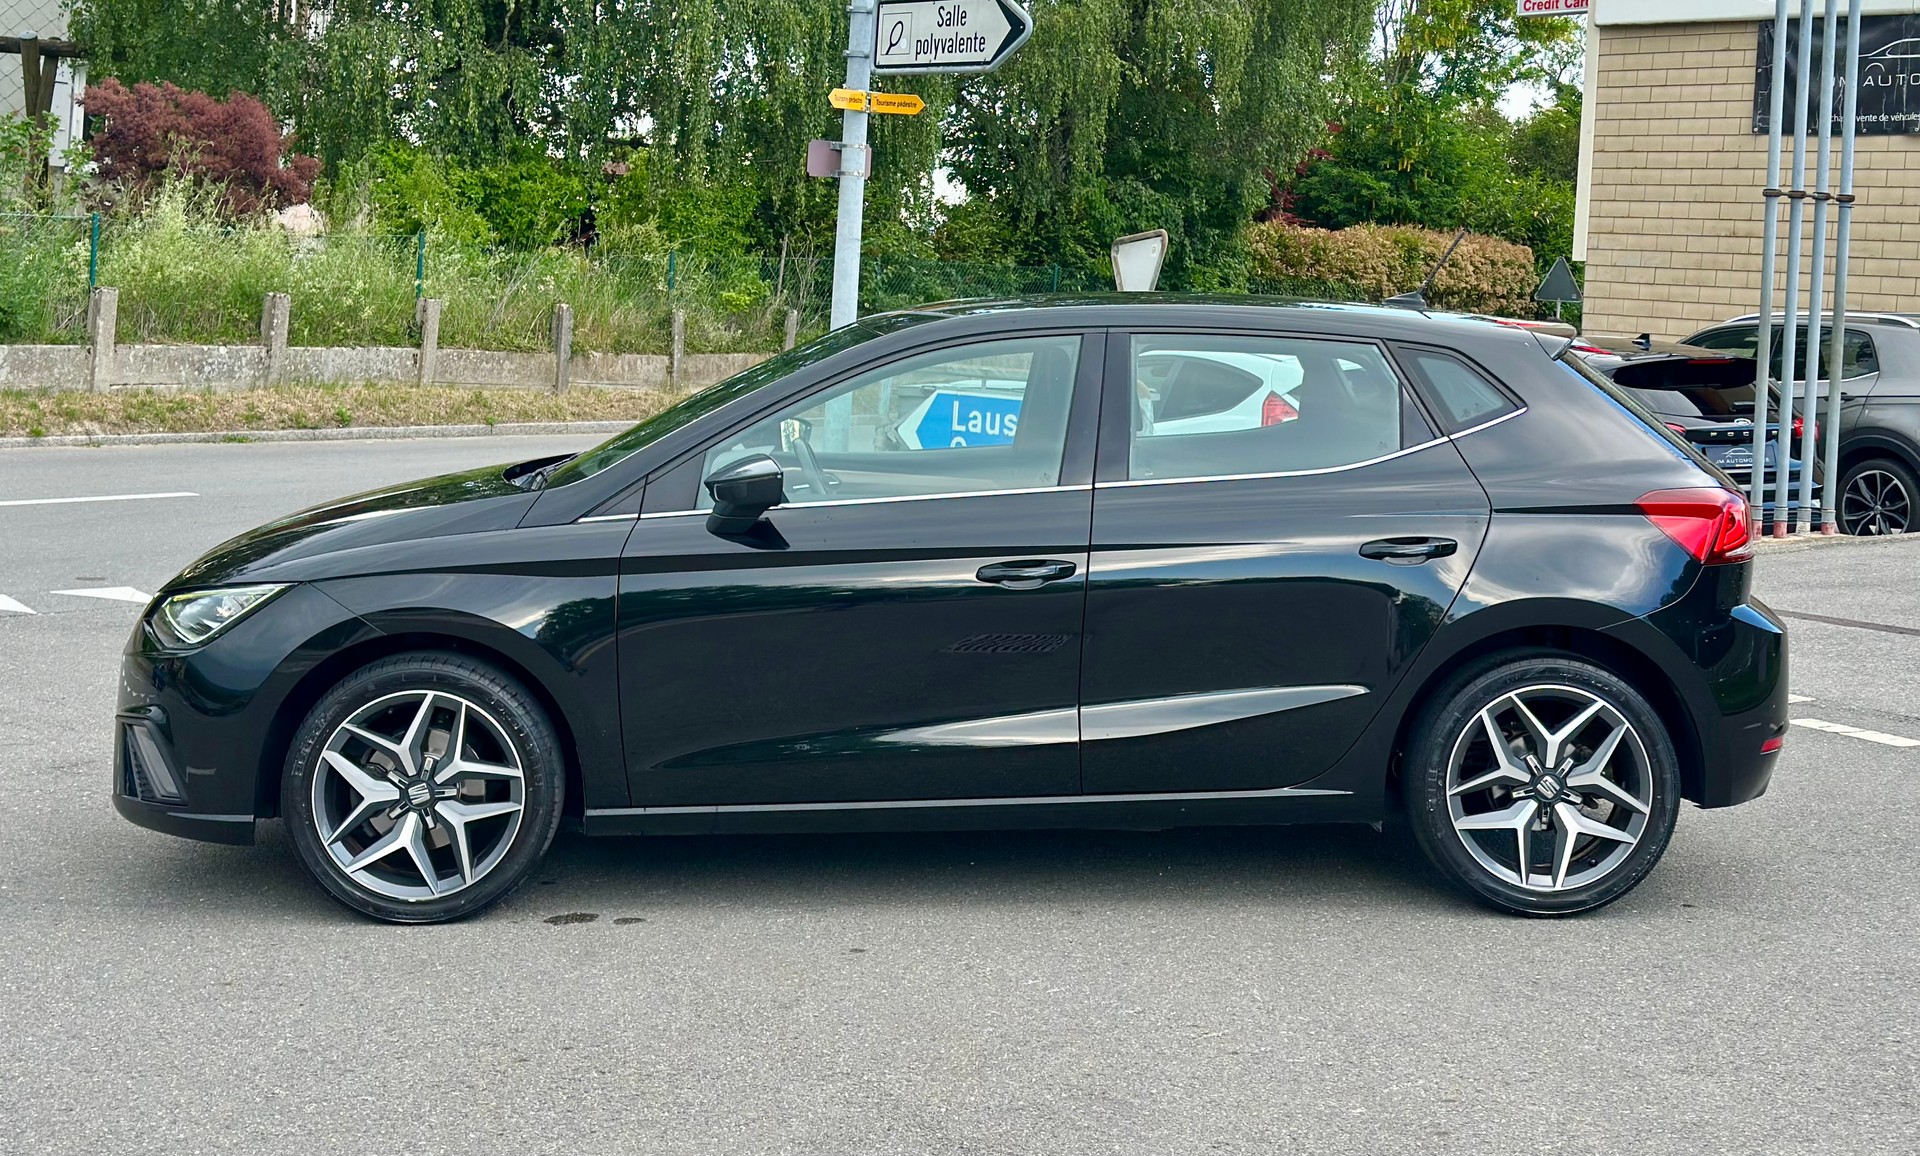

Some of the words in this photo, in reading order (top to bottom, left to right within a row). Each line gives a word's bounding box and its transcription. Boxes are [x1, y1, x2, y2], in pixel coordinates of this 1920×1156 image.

[1523, 0, 1559, 11] Credit
[937, 5, 967, 27] Salle
[915, 31, 986, 61] polyvalente
[876, 99, 896, 107] Tourisme
[896, 101, 917, 109] pédestre
[1855, 114, 1878, 122] vente
[1878, 113, 1889, 122] de
[952, 400, 1018, 437] Laus
